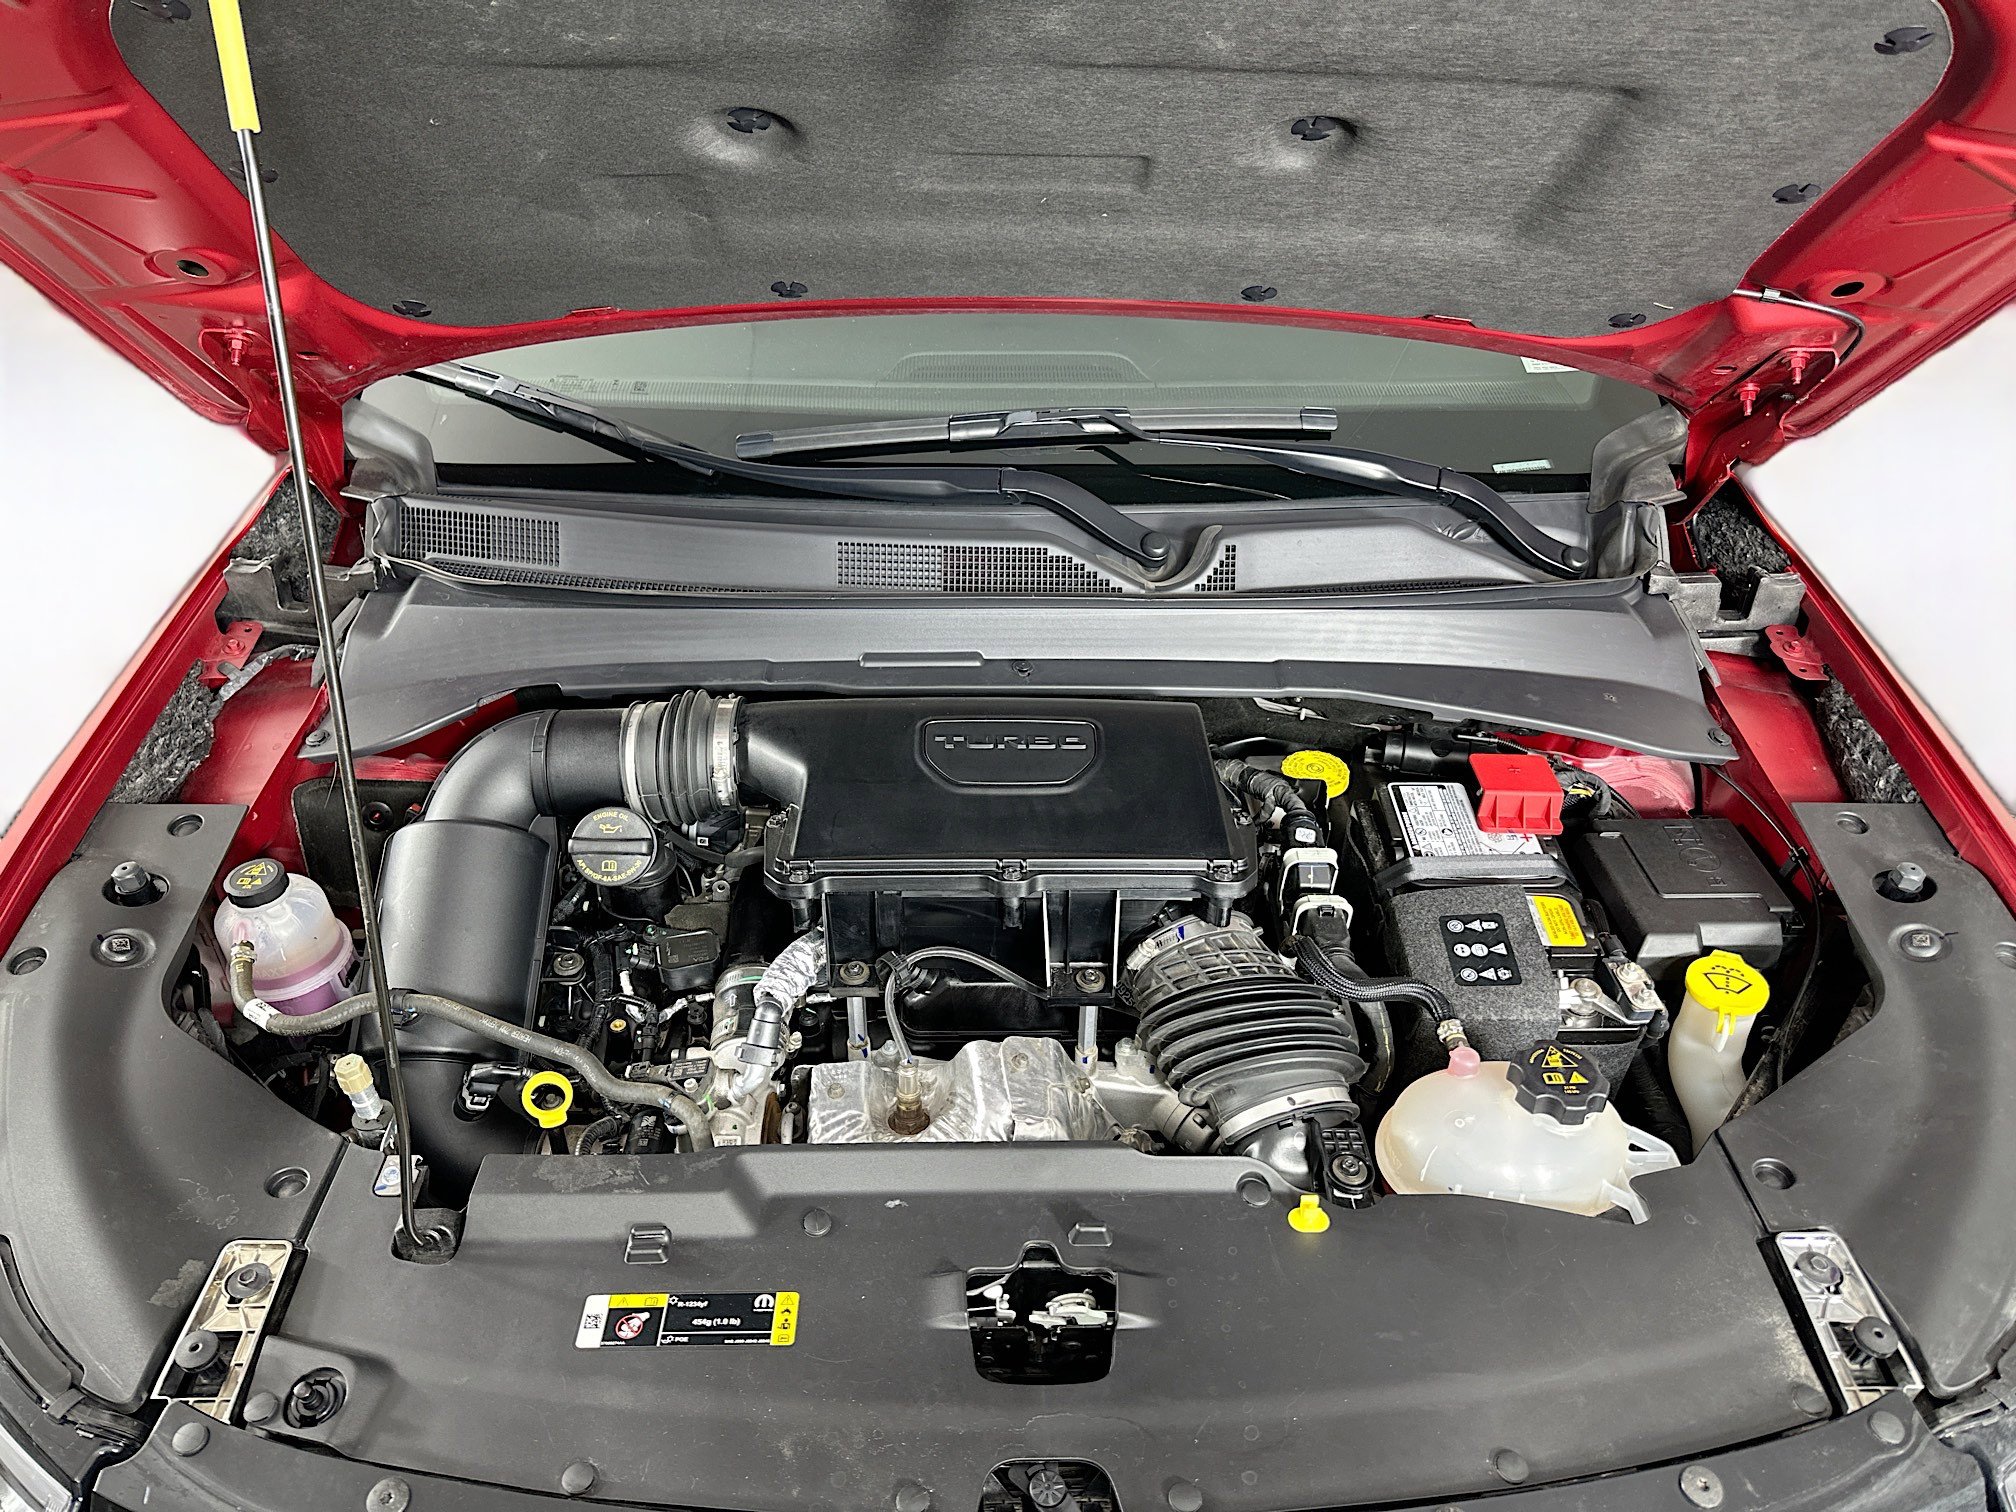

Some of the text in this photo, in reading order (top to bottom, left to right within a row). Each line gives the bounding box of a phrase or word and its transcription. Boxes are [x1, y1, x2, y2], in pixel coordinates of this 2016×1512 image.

[934, 734, 1087, 750] TURBO
[592, 811, 629, 822] ENGINE OIL
[510, 1030, 532, 1044] HEATER
[677, 1300, 708, 1308] R-1234yf
[692, 1318, 742, 1326] 454g (1.0 lb)
